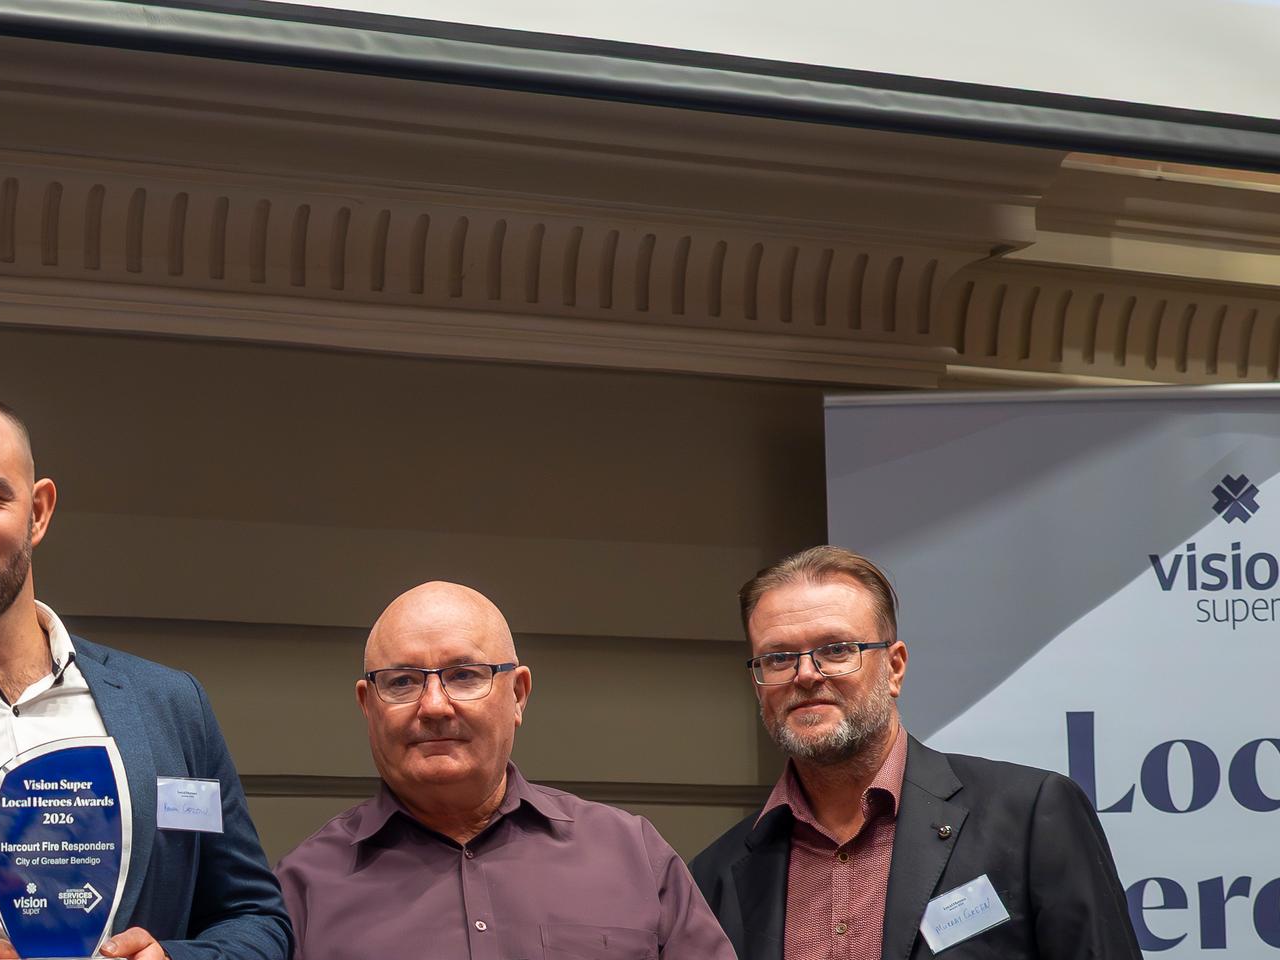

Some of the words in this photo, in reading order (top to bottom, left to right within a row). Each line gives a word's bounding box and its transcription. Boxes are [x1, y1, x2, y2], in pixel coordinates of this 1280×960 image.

[23, 779, 58, 790] Vision
[60, 779, 92, 792] Super
[1, 797, 31, 808] Local
[33, 796, 72, 807] Heroes
[74, 796, 114, 807] Awards
[42, 813, 74, 824] 2026
[0, 842, 40, 852] Harcourt
[42, 842, 60, 852] Fire
[62, 841, 115, 852] Responders
[16, 857, 30, 867] City
[32, 857, 40, 865] of
[41, 857, 68, 865] Greater
[70, 856, 100, 866] Bendigo
[13, 896, 48, 908] vision
